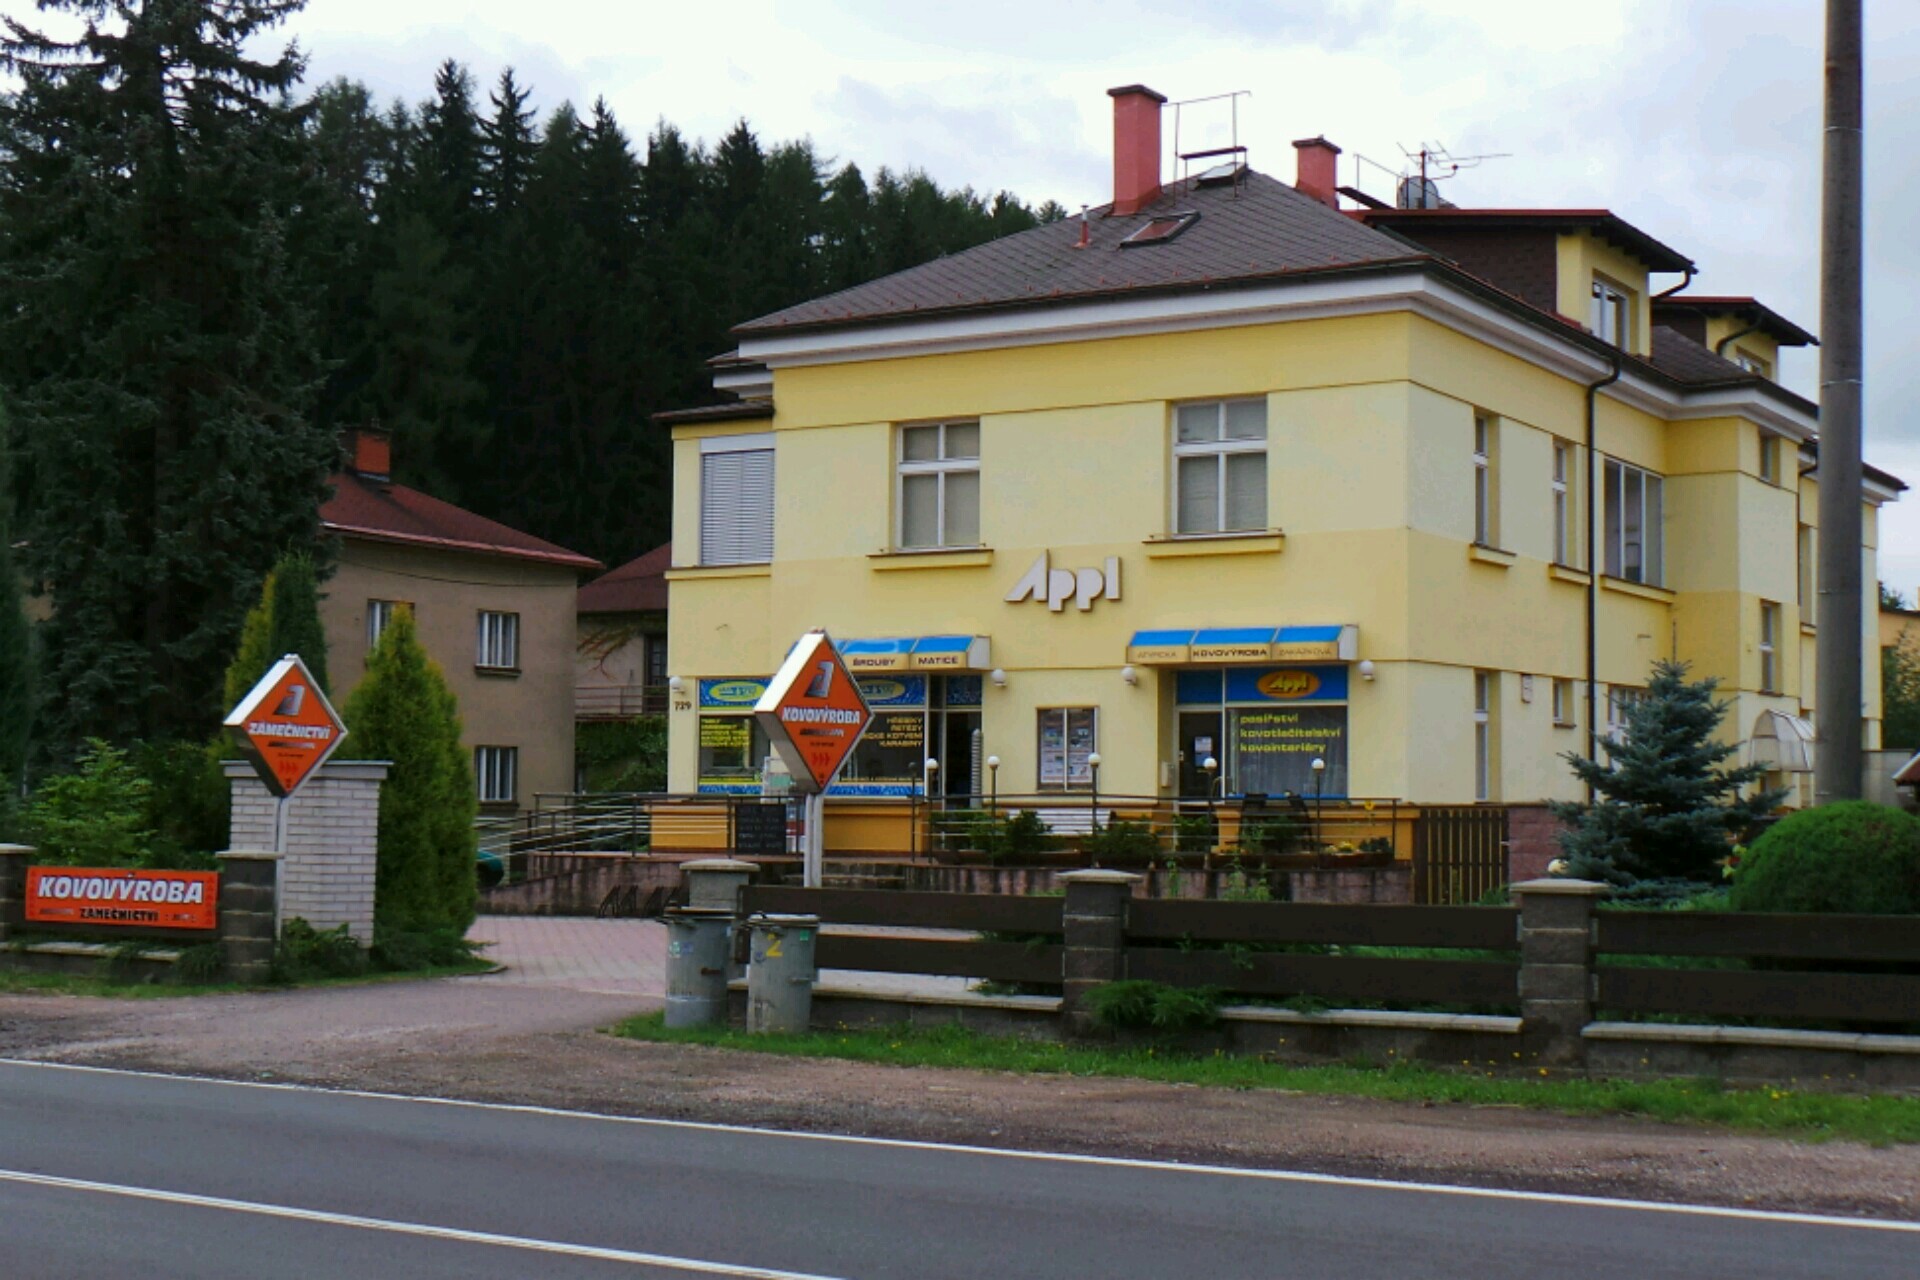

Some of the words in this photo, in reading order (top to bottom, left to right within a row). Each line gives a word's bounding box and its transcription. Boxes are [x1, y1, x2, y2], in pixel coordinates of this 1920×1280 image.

[1003, 549, 1121, 612] Appl
[918, 656, 958, 665] MATICE
[1193, 648, 1267, 657] KOVOVÝROBA
[781, 705, 861, 725] KOVOVÝROBA
[37, 872, 204, 904] KOVOVÝROBA
